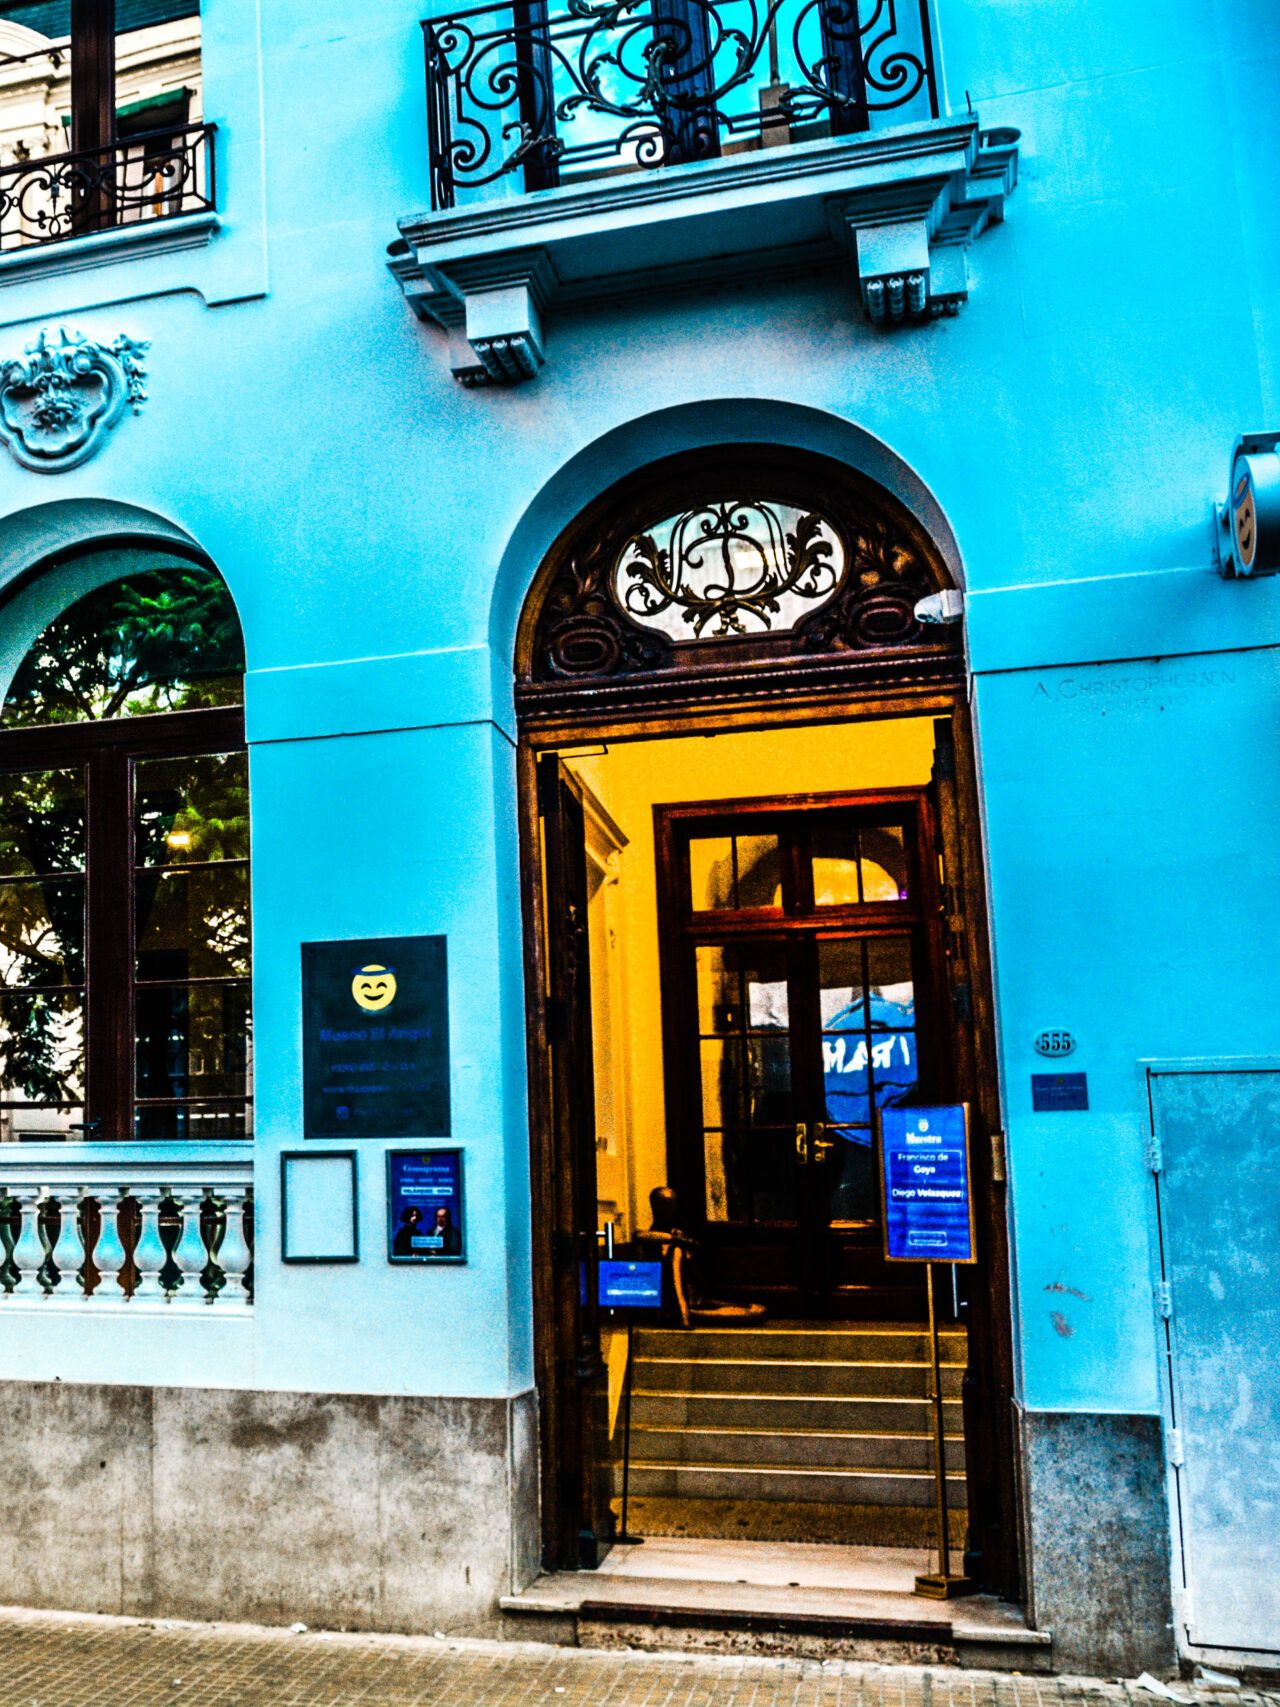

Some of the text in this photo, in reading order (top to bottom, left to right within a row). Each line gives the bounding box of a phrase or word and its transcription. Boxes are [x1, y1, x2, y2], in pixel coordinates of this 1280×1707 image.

[320, 1027, 368, 1041] Museo
[1041, 1033, 1071, 1051] 555
[898, 1153, 949, 1162] Francisco de
[913, 1165, 936, 1175] Goya
[892, 1188, 916, 1200] Diego
